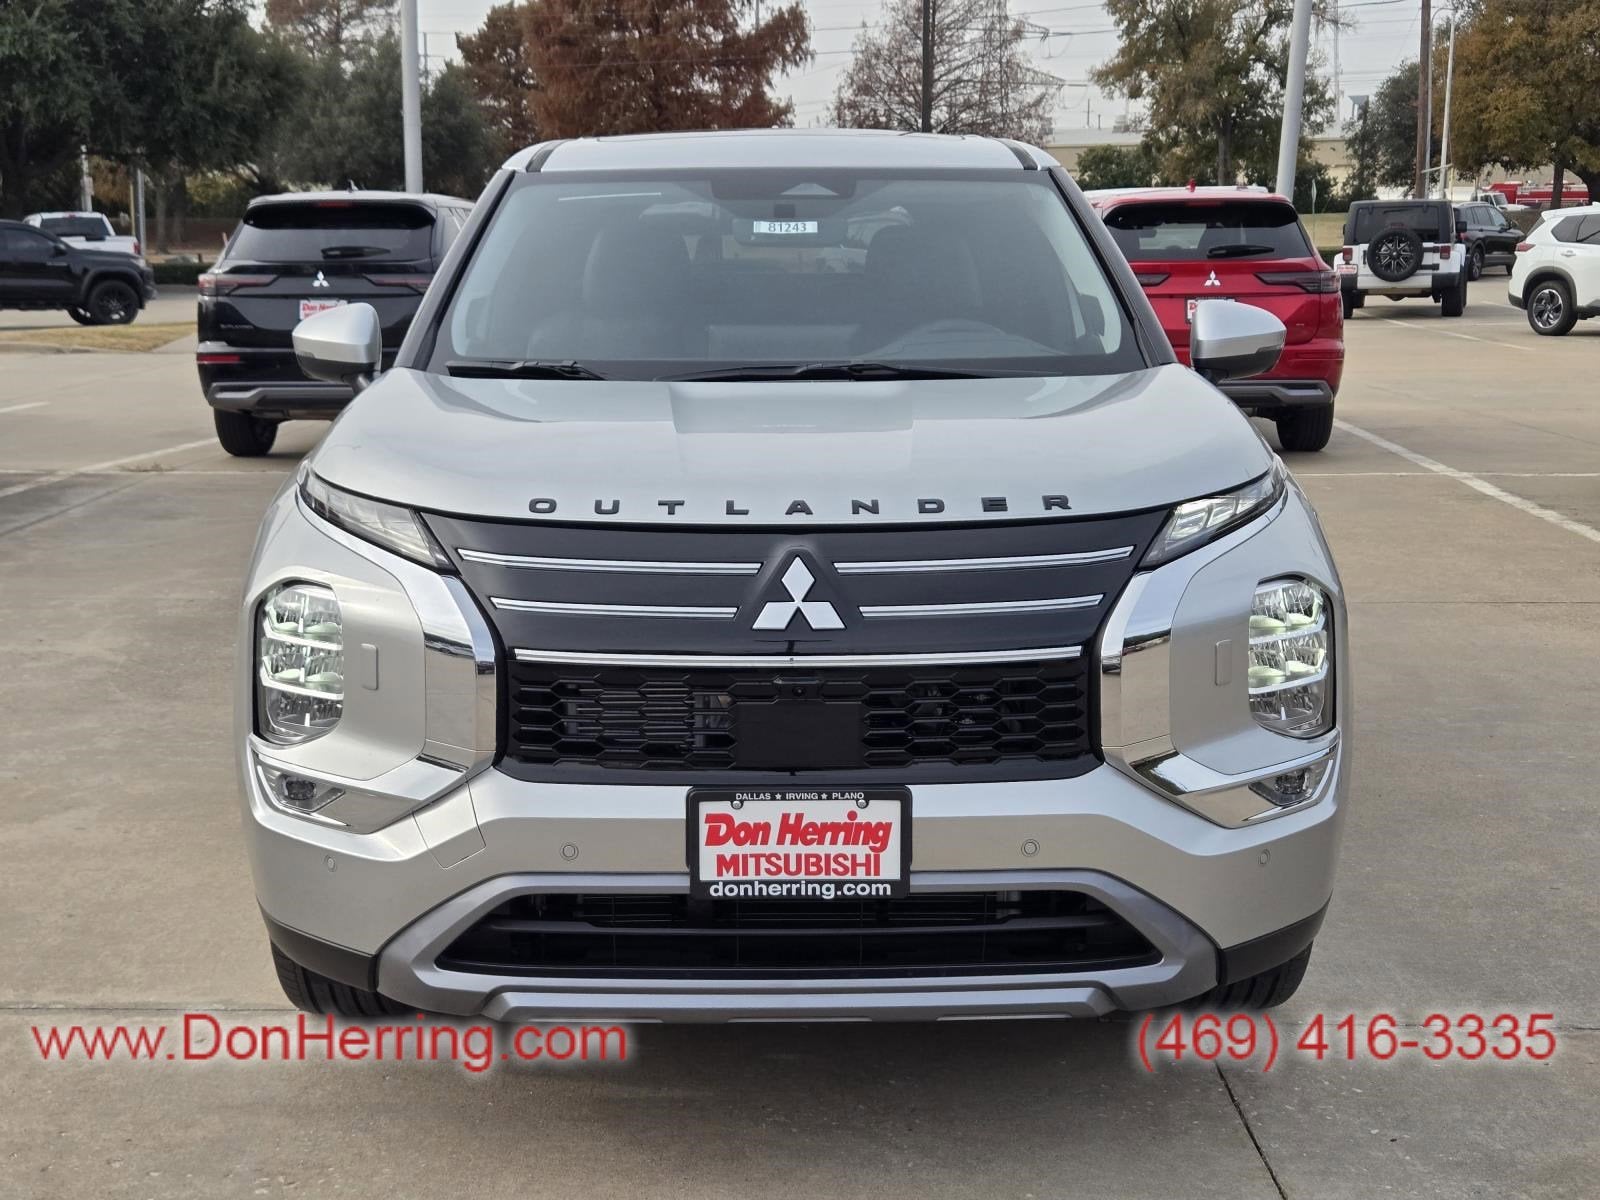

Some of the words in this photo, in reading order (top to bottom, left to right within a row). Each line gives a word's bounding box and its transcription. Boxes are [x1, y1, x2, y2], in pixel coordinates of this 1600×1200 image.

[768, 222, 807, 233] 81243
[527, 494, 1073, 516] OUTLANDER
[735, 792, 772, 801] DALLAS
[785, 792, 819, 801] IRVING
[832, 791, 865, 800] PLANO
[704, 813, 772, 847] Don
[776, 810, 893, 853] Herring
[716, 853, 881, 877] MITSUBISHI
[709, 881, 892, 899] donherring.com
